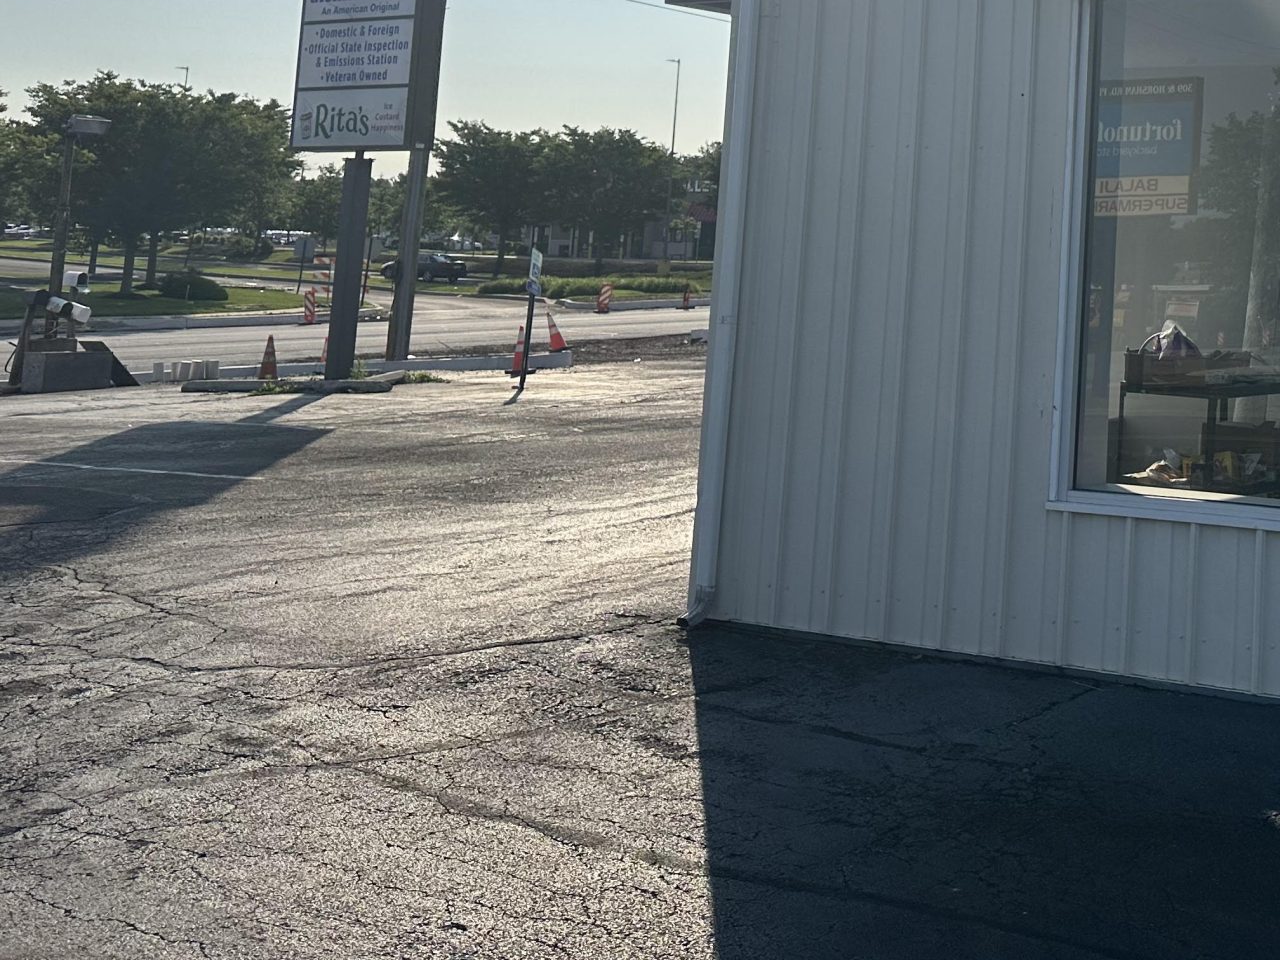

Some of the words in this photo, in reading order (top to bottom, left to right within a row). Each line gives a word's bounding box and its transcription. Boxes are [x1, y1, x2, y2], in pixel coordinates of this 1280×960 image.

[321, 7, 332, 15] An
[333, 4, 369, 15] American
[370, 2, 400, 14] Original
[320, 25, 358, 39] Domestic
[360, 25, 366, 37] &
[368, 24, 400, 36] Foreign
[308, 42, 338, 55] Official
[341, 41, 362, 53] State
[364, 39, 409, 53] Inspection
[315, 57, 321, 68] &
[324, 56, 365, 67] Emissions
[367, 54, 398, 66] Station
[325, 71, 357, 83] Veteran
[359, 69, 388, 81] Owned
[314, 103, 369, 139] Rita's
